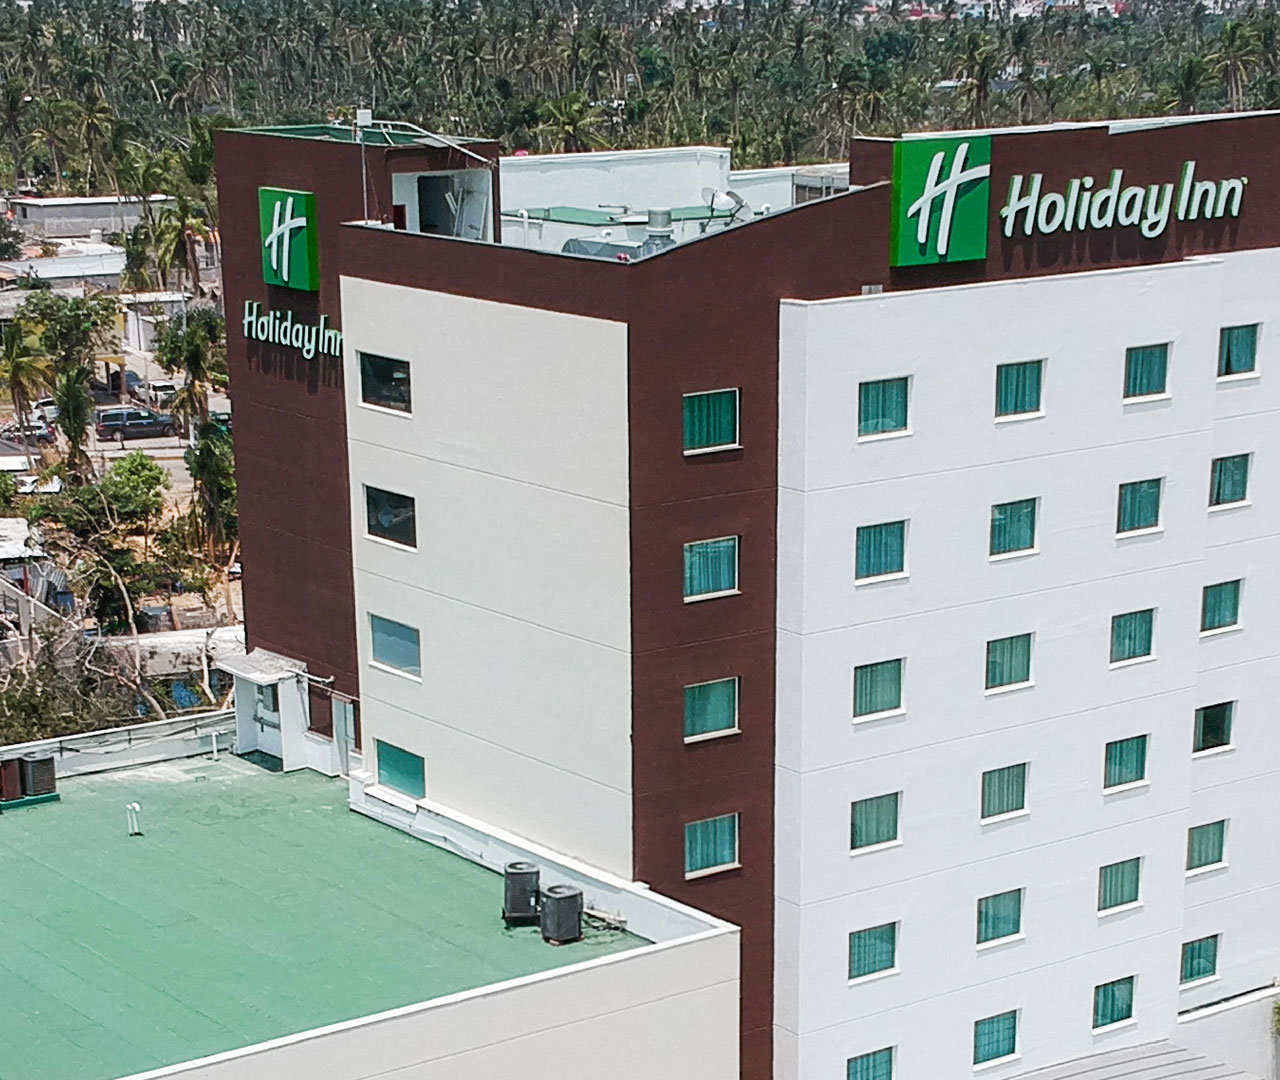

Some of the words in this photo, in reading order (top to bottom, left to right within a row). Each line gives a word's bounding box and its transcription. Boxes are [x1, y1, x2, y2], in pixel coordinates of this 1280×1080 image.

[1000, 168, 1174, 239] Holiday
[1176, 160, 1245, 221] Inn
[242, 300, 319, 360] Holiday
